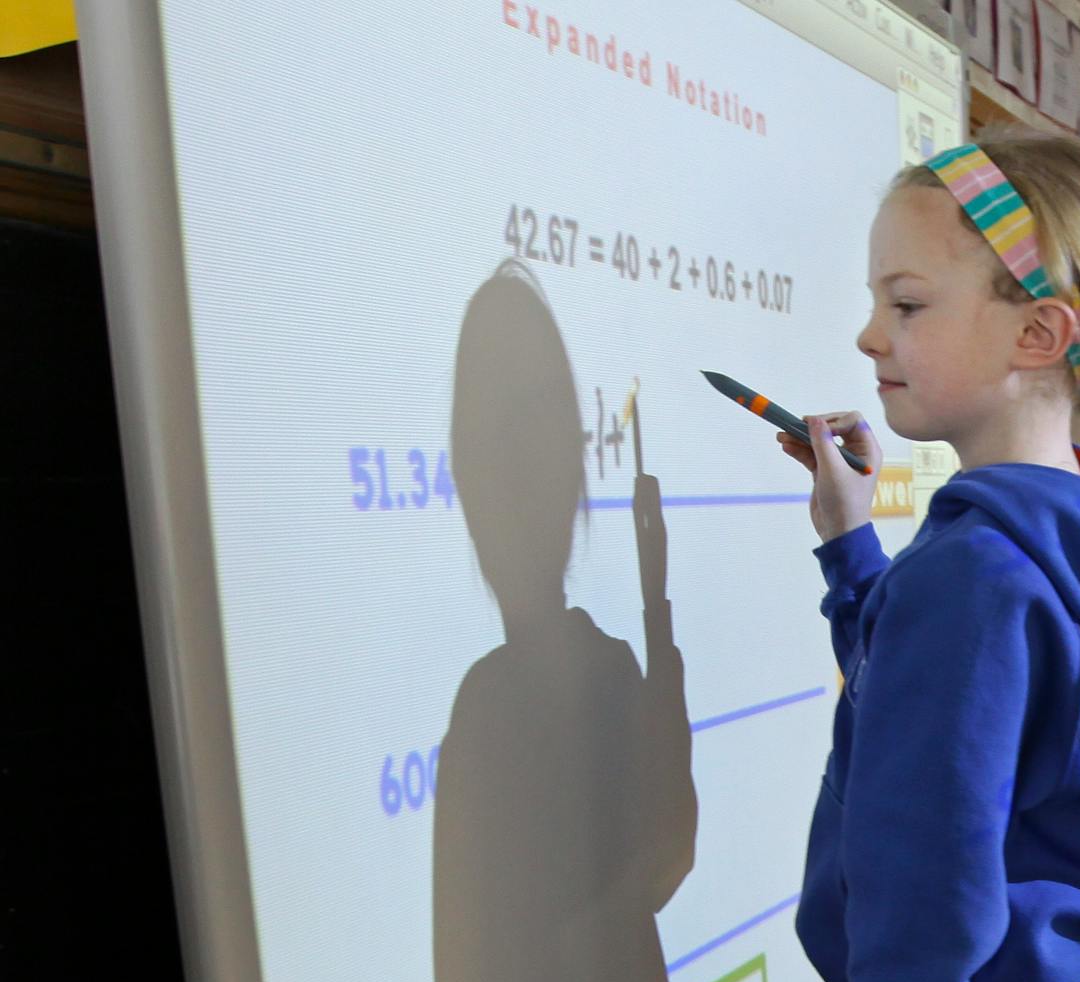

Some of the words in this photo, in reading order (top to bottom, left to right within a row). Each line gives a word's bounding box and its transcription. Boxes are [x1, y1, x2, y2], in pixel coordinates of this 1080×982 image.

[502, 0, 653, 88] Expanded
[666, 60, 767, 137] Notation
[505, 203, 579, 268] 42.67
[611, 230, 641, 282] 40
[668, 245, 682, 292] 2
[706, 255, 736, 302] 0.6
[757, 268, 793, 314] 0.07
[348, 446, 457, 512] 51.34
